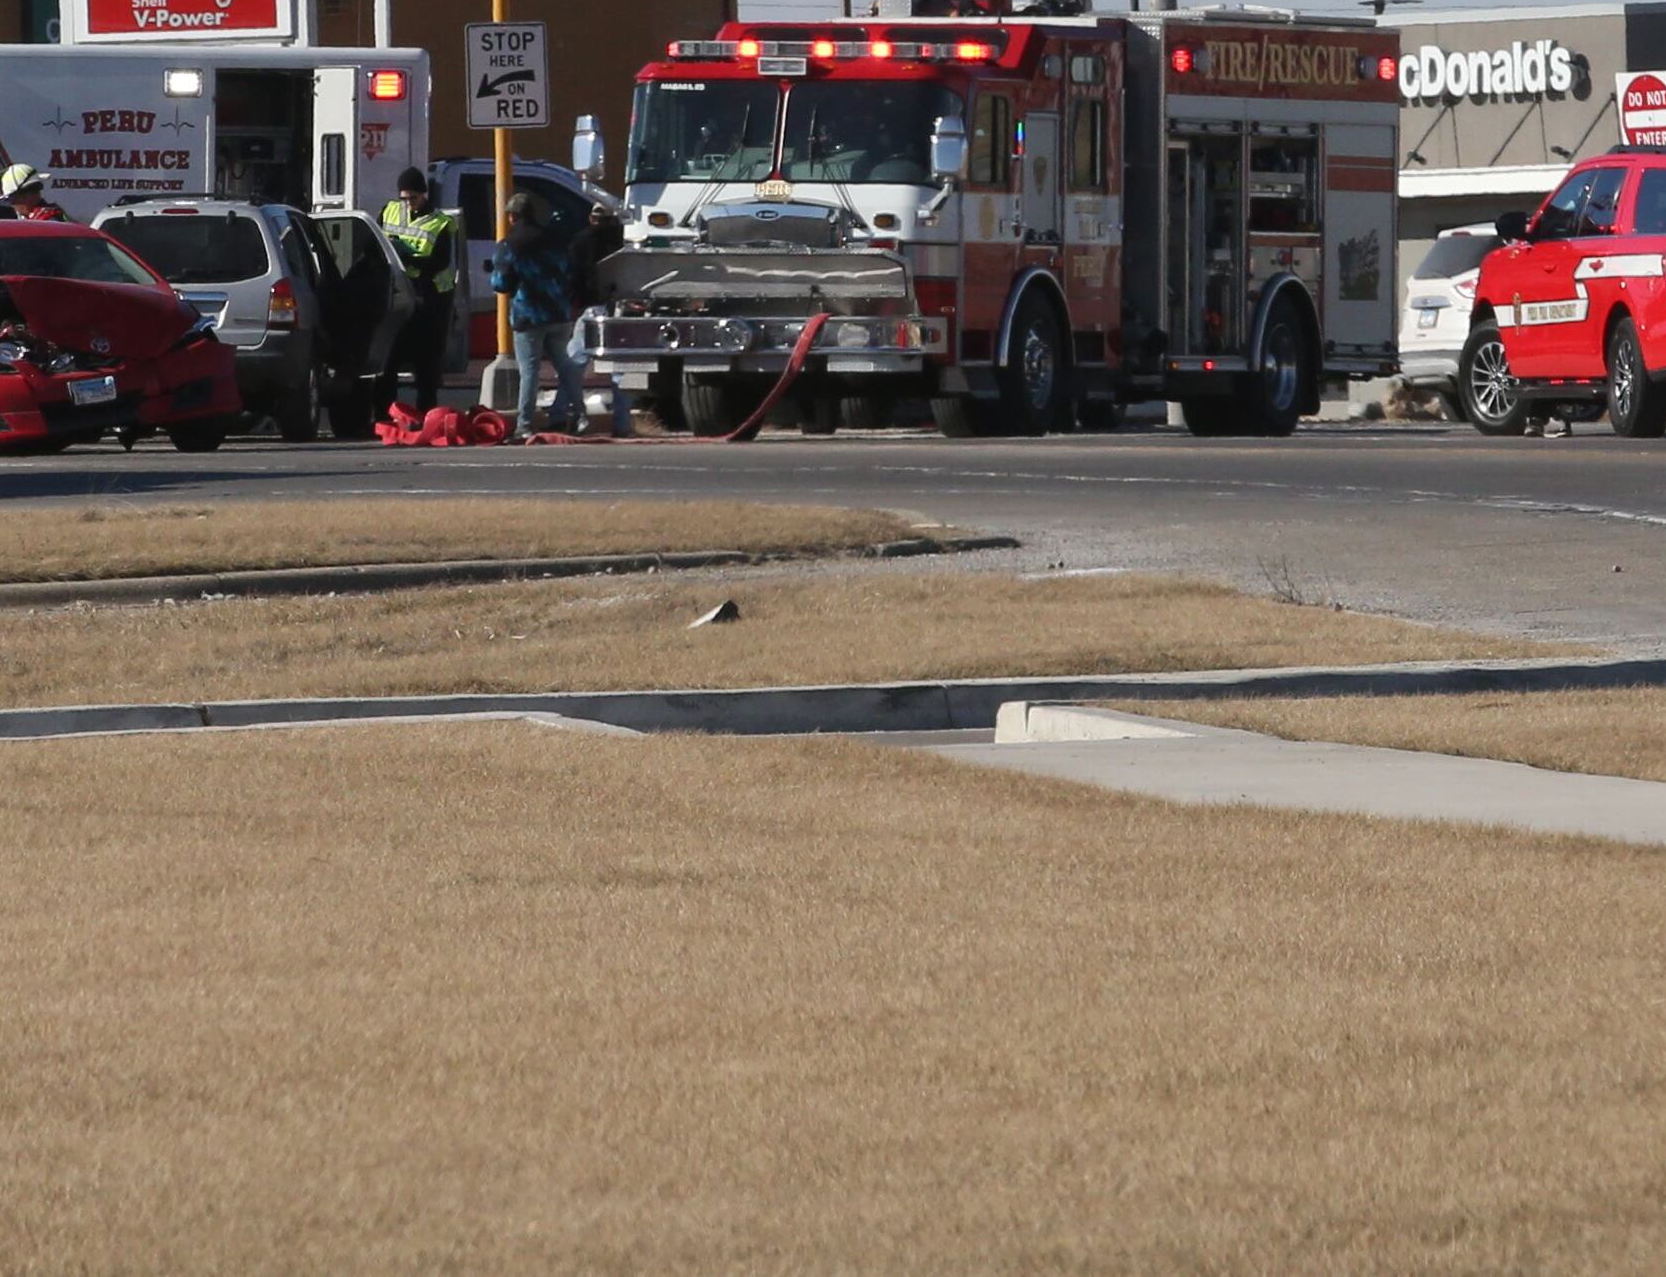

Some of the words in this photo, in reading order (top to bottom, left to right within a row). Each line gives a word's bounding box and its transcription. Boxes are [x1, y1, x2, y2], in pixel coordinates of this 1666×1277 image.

[133, 9, 226, 28] V-Power
[481, 32, 535, 52] STOP
[490, 55, 525, 67] HERE
[1398, 39, 1572, 99] cDonald's
[508, 83, 525, 95] ON
[1628, 92, 1643, 107] DO
[1647, 90, 1666, 107] NOT
[497, 99, 539, 118] RED
[81, 110, 157, 134] PERU
[48, 149, 190, 170] AMBULANCE
[52, 179, 110, 190] ADVANCED
[111, 179, 135, 190] LIFE
[137, 180, 184, 191] SUPPORT
